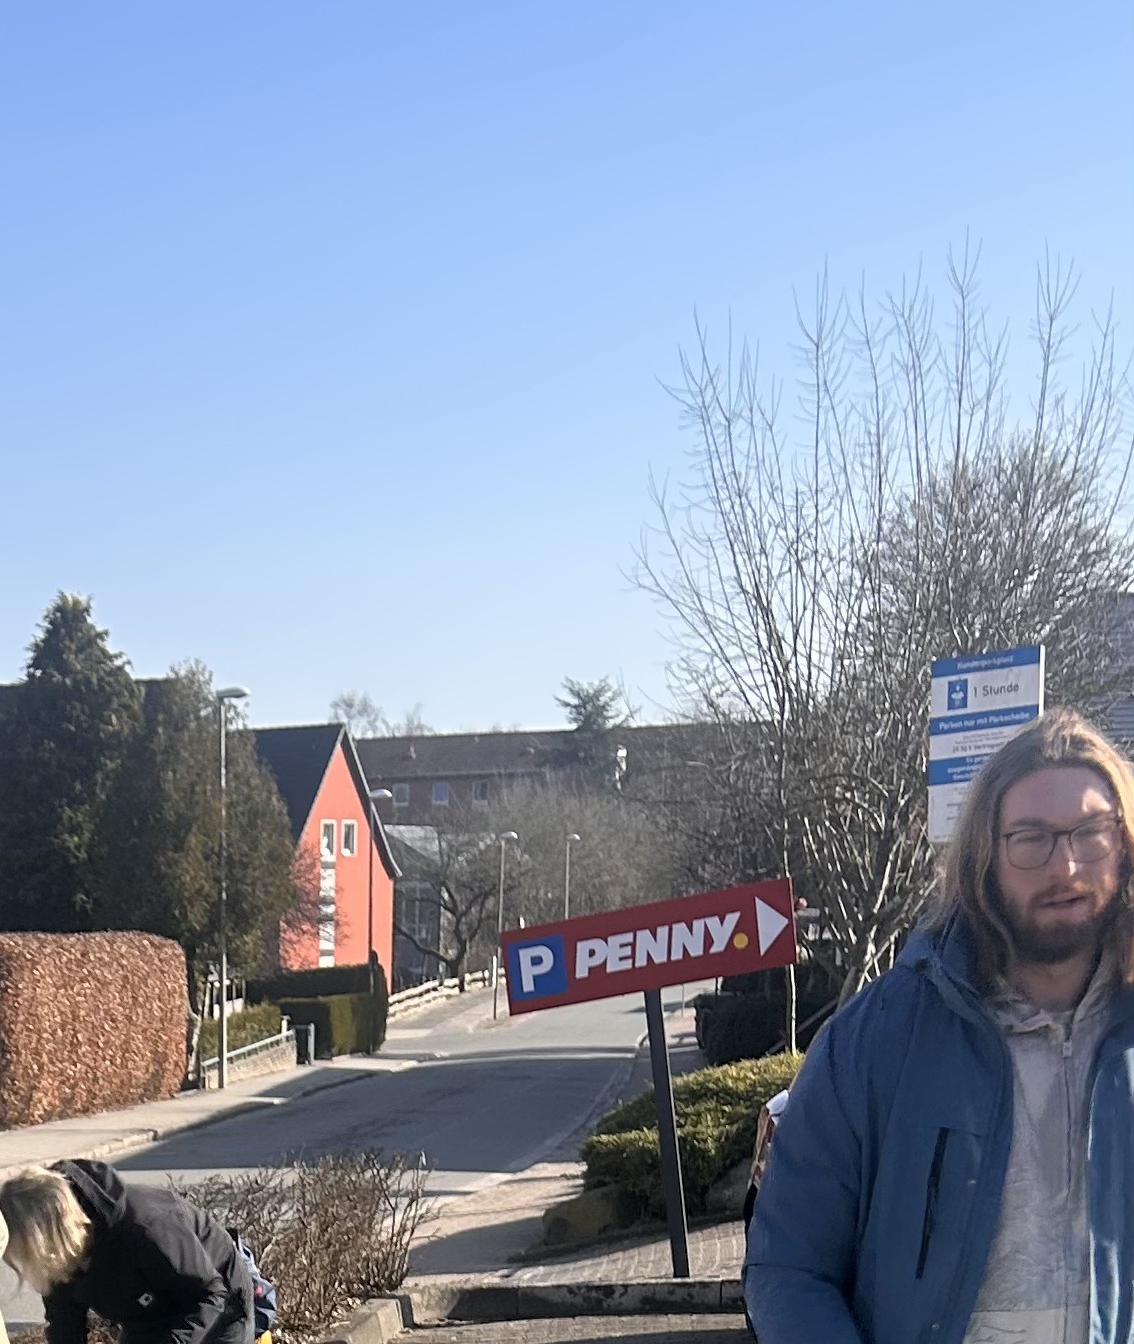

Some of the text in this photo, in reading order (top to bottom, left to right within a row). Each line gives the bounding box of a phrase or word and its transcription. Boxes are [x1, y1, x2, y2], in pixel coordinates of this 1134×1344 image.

[973, 683, 1019, 698] 1 Stunde
[518, 944, 555, 993] P
